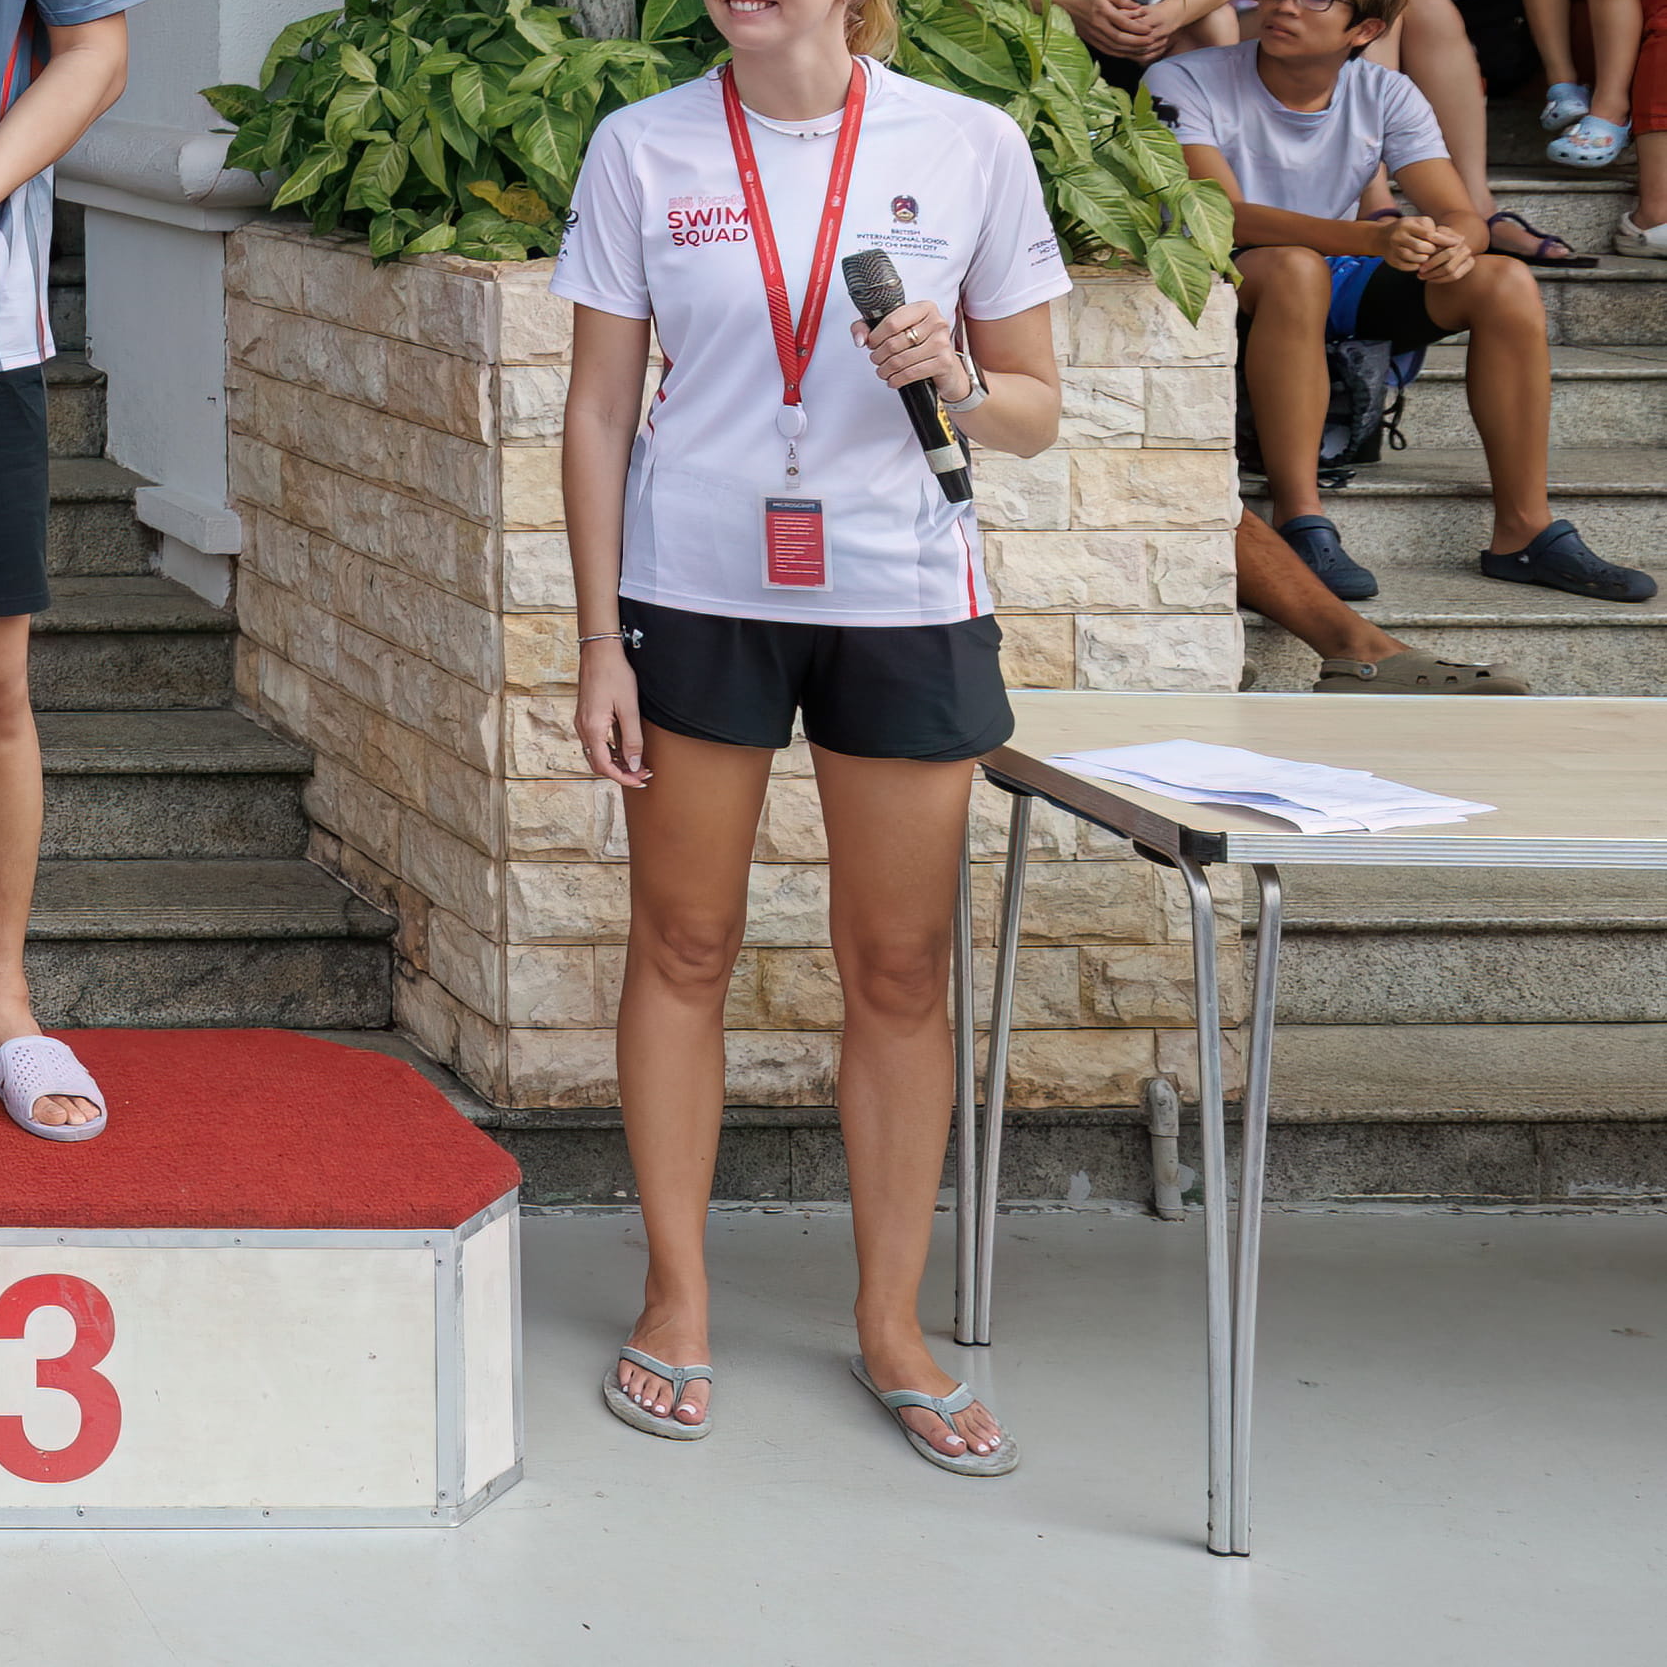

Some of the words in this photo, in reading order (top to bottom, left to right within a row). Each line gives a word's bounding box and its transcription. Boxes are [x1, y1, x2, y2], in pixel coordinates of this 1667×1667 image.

[667, 207, 748, 230] SWIM
[672, 228, 748, 247] SQUAD
[856, 233, 920, 243] INTERNATIONAL
[921, 237, 949, 246] SCHOOL
[871, 240, 883, 248] HO
